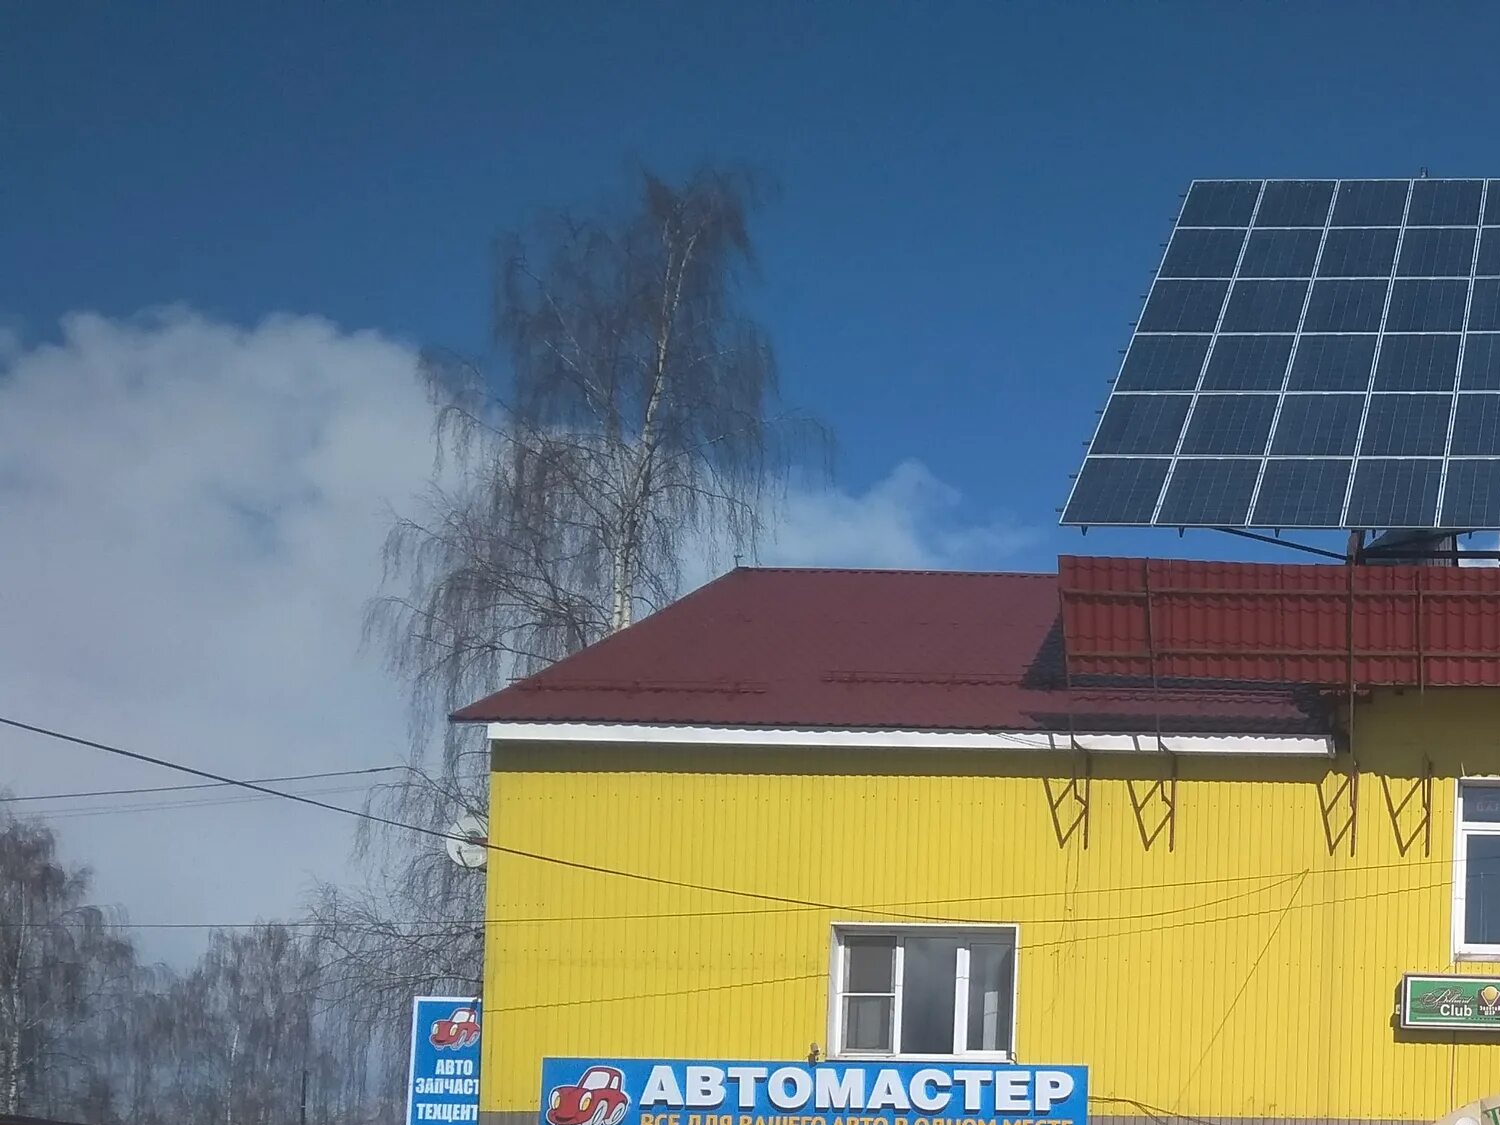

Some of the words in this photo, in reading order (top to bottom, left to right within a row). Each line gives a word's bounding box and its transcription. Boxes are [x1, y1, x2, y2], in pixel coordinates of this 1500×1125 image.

[1440, 1004, 1472, 1016] Club
[435, 1059, 473, 1076] АВТО
[639, 1065, 1075, 1113] АВТОМАСТЕР
[416, 1103, 478, 1123] ТЕХЦЕНТ
